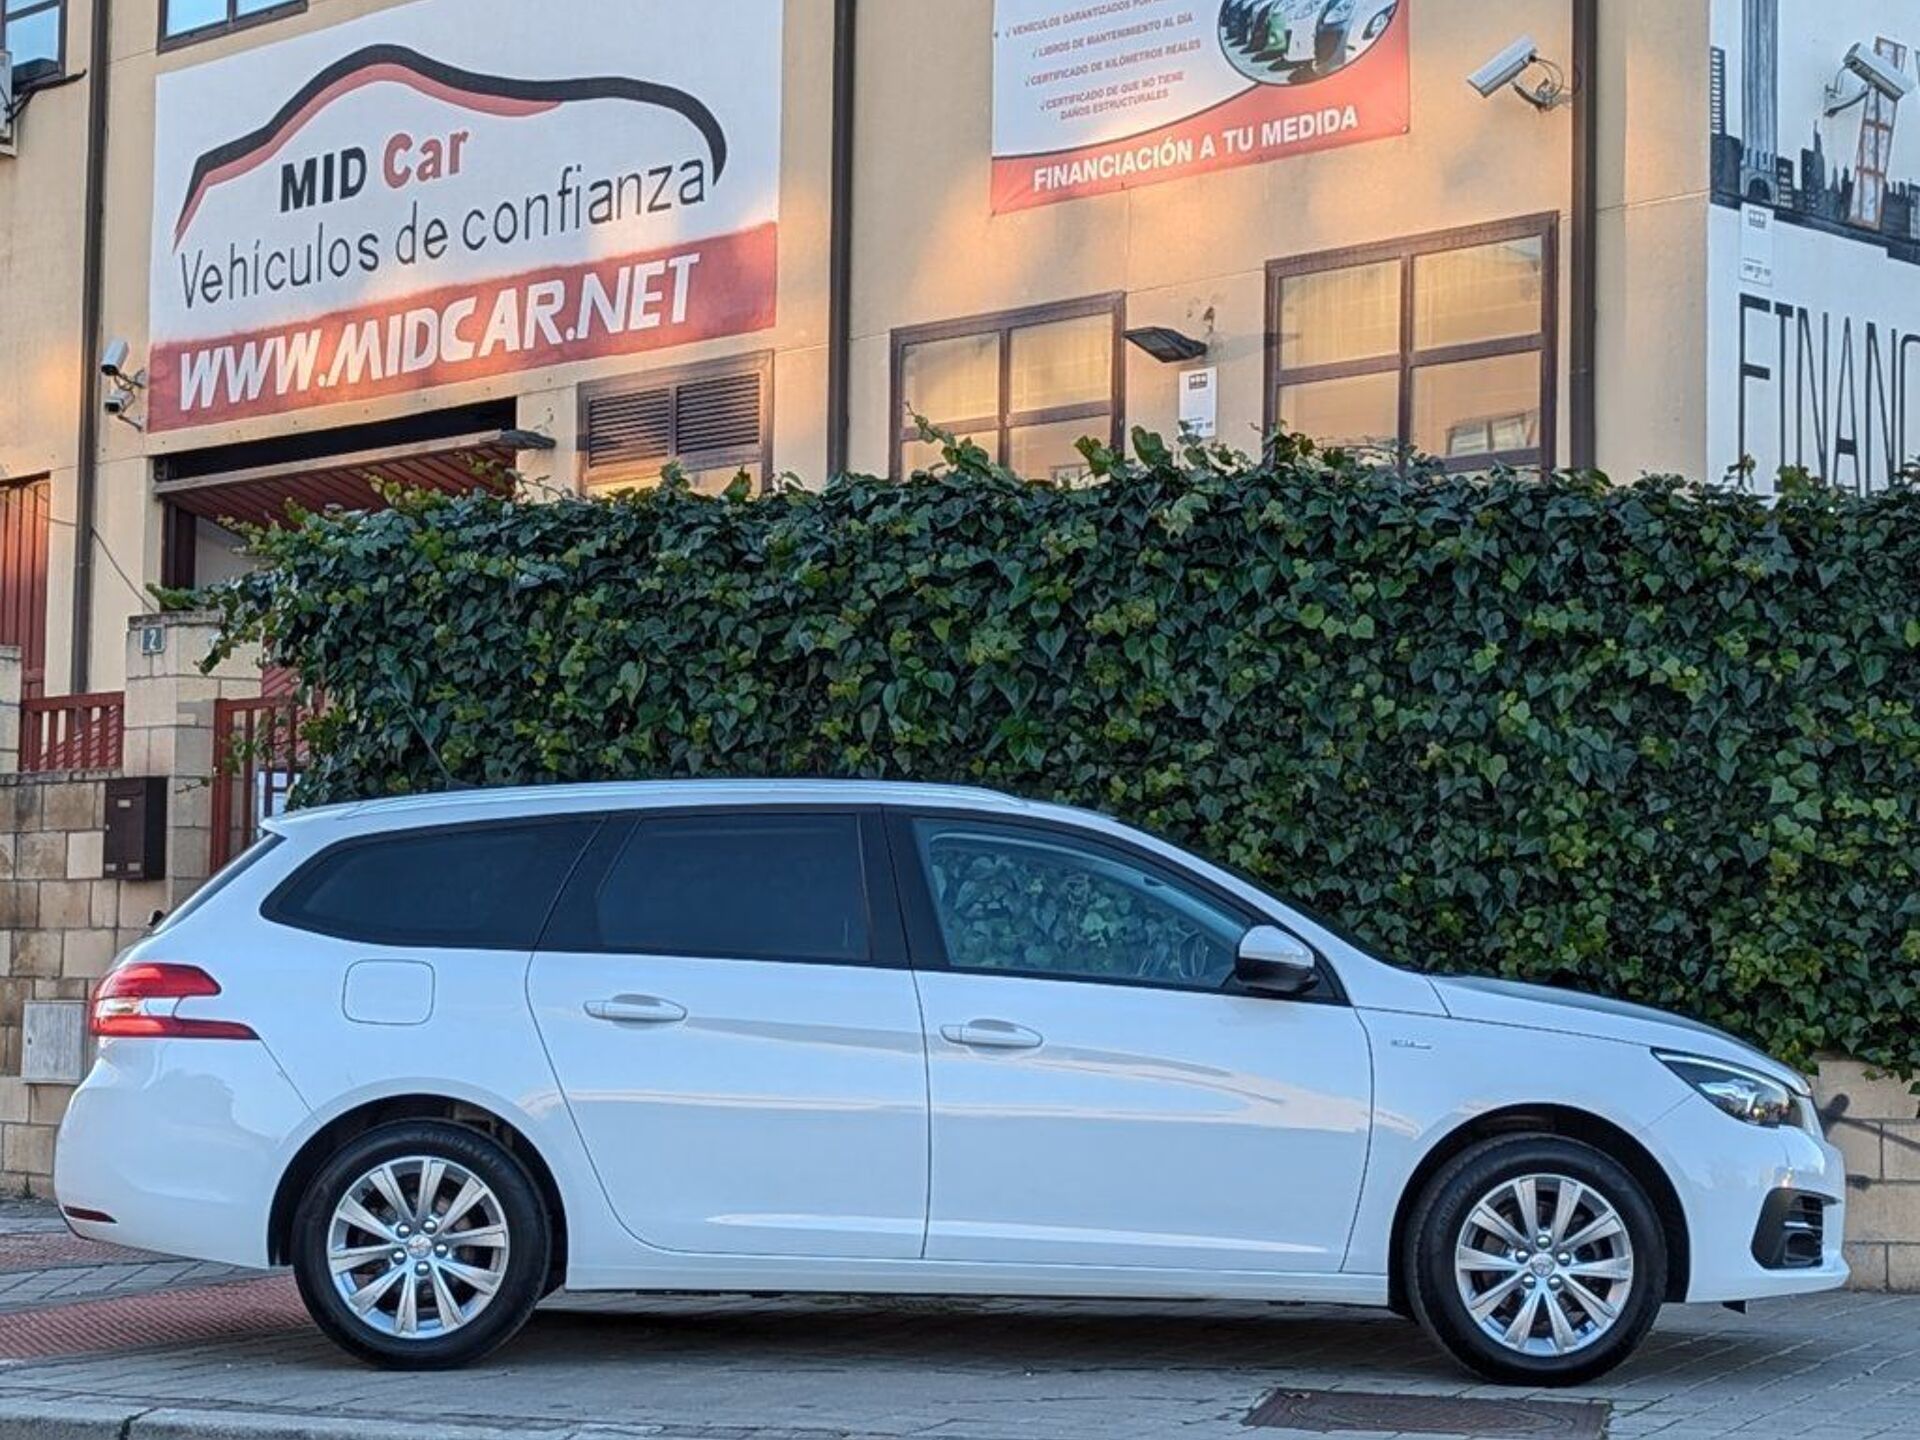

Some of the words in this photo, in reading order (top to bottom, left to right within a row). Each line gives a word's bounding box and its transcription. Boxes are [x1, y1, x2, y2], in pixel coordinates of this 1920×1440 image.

[1072, 37, 1084, 49] DE
[1163, 16, 1175, 28] AL
[1030, 63, 1089, 87] CERTIFICADO
[1091, 60, 1102, 73] DE
[1045, 87, 1104, 110] CERTIFICADO
[1106, 84, 1118, 97] DE
[1121, 80, 1139, 94] QUE
[1142, 76, 1156, 88] NO
[280, 146, 367, 213] MID
[383, 130, 469, 189] Car
[1033, 137, 1193, 193] FINANCIACIÓN
[1199, 136, 1216, 159] A
[1223, 125, 1254, 152] TU
[1261, 104, 1359, 147] MEDIDA
[181, 222, 380, 309] Vehículos
[395, 200, 448, 265] de
[462, 158, 706, 251] confianza
[178, 253, 700, 412] WWW.MIDCAR.NET
[149, 628, 157, 650] 2
